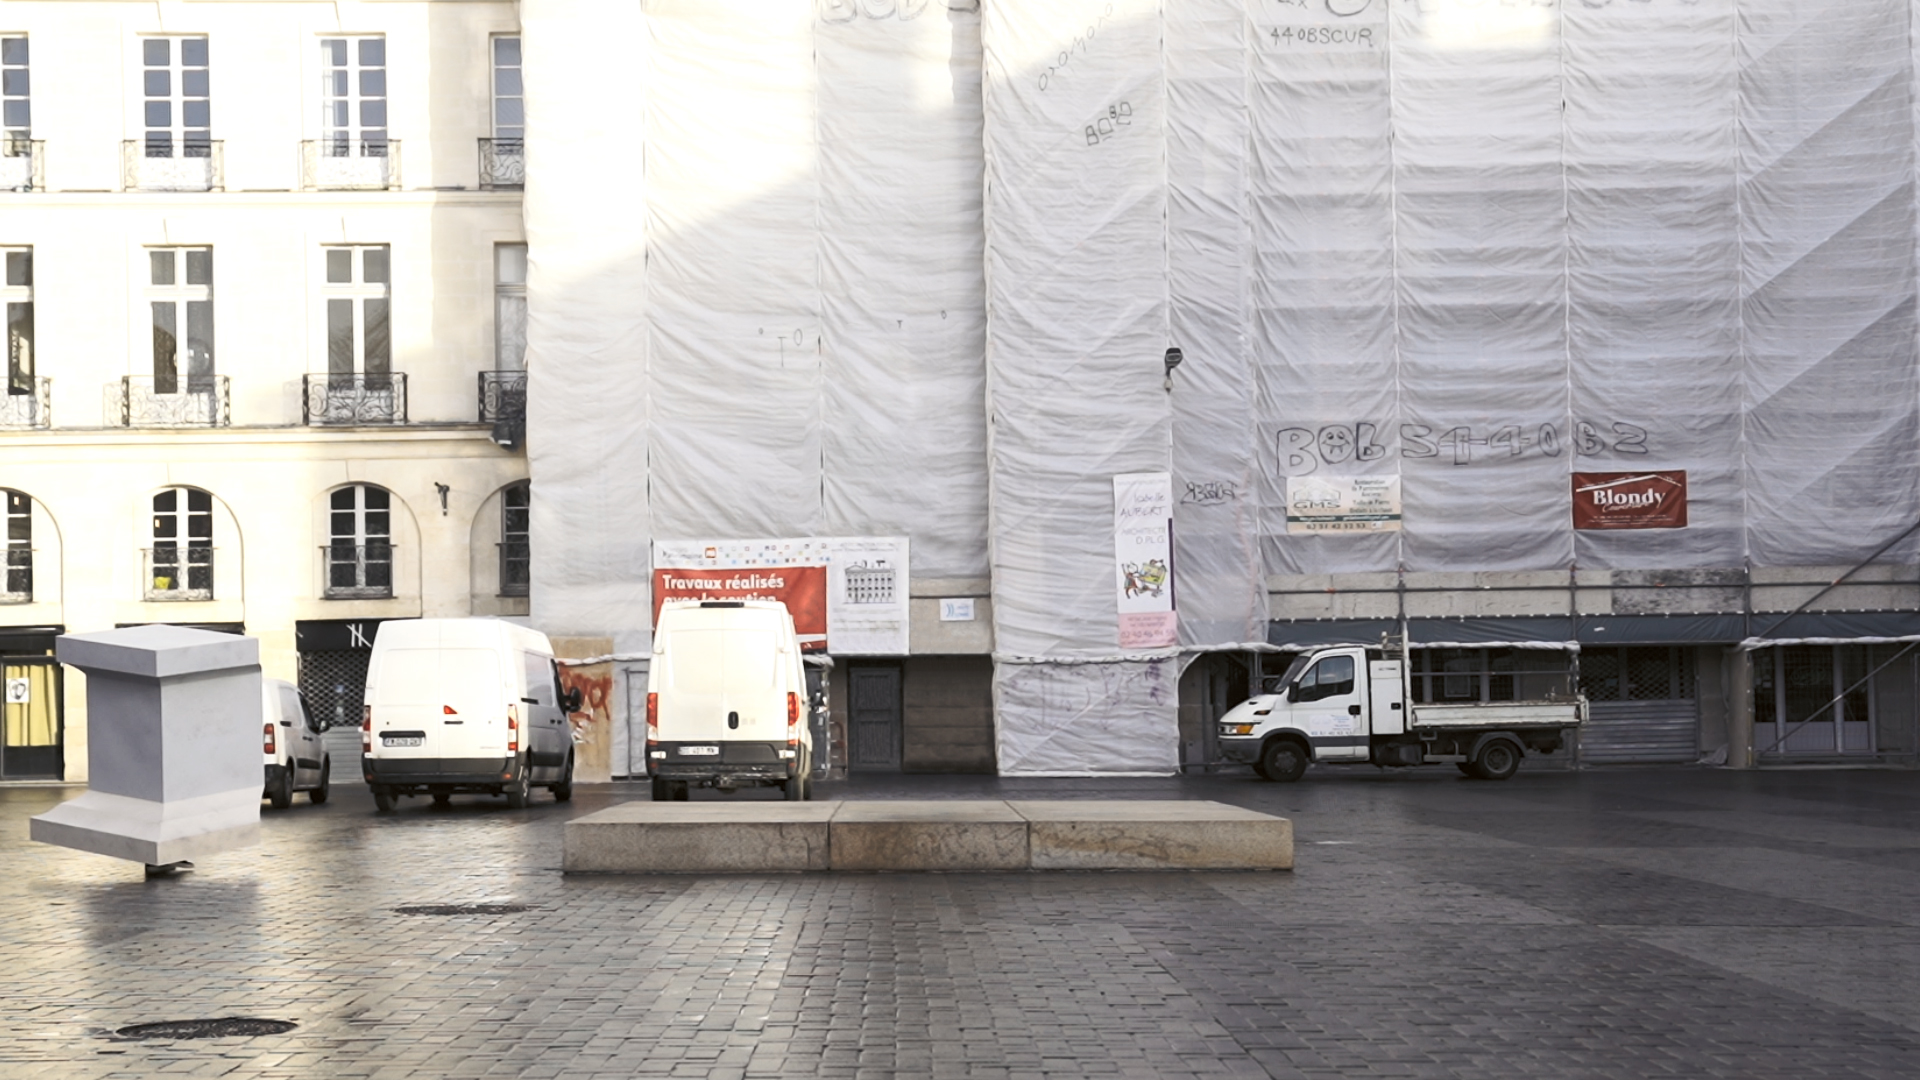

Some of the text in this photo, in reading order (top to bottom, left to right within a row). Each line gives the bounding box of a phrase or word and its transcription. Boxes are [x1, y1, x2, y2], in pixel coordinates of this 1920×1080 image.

[1293, 501, 1341, 509] GMS
[1593, 488, 1666, 508] Blondy
[662, 572, 785, 590] Travaux réalisés
